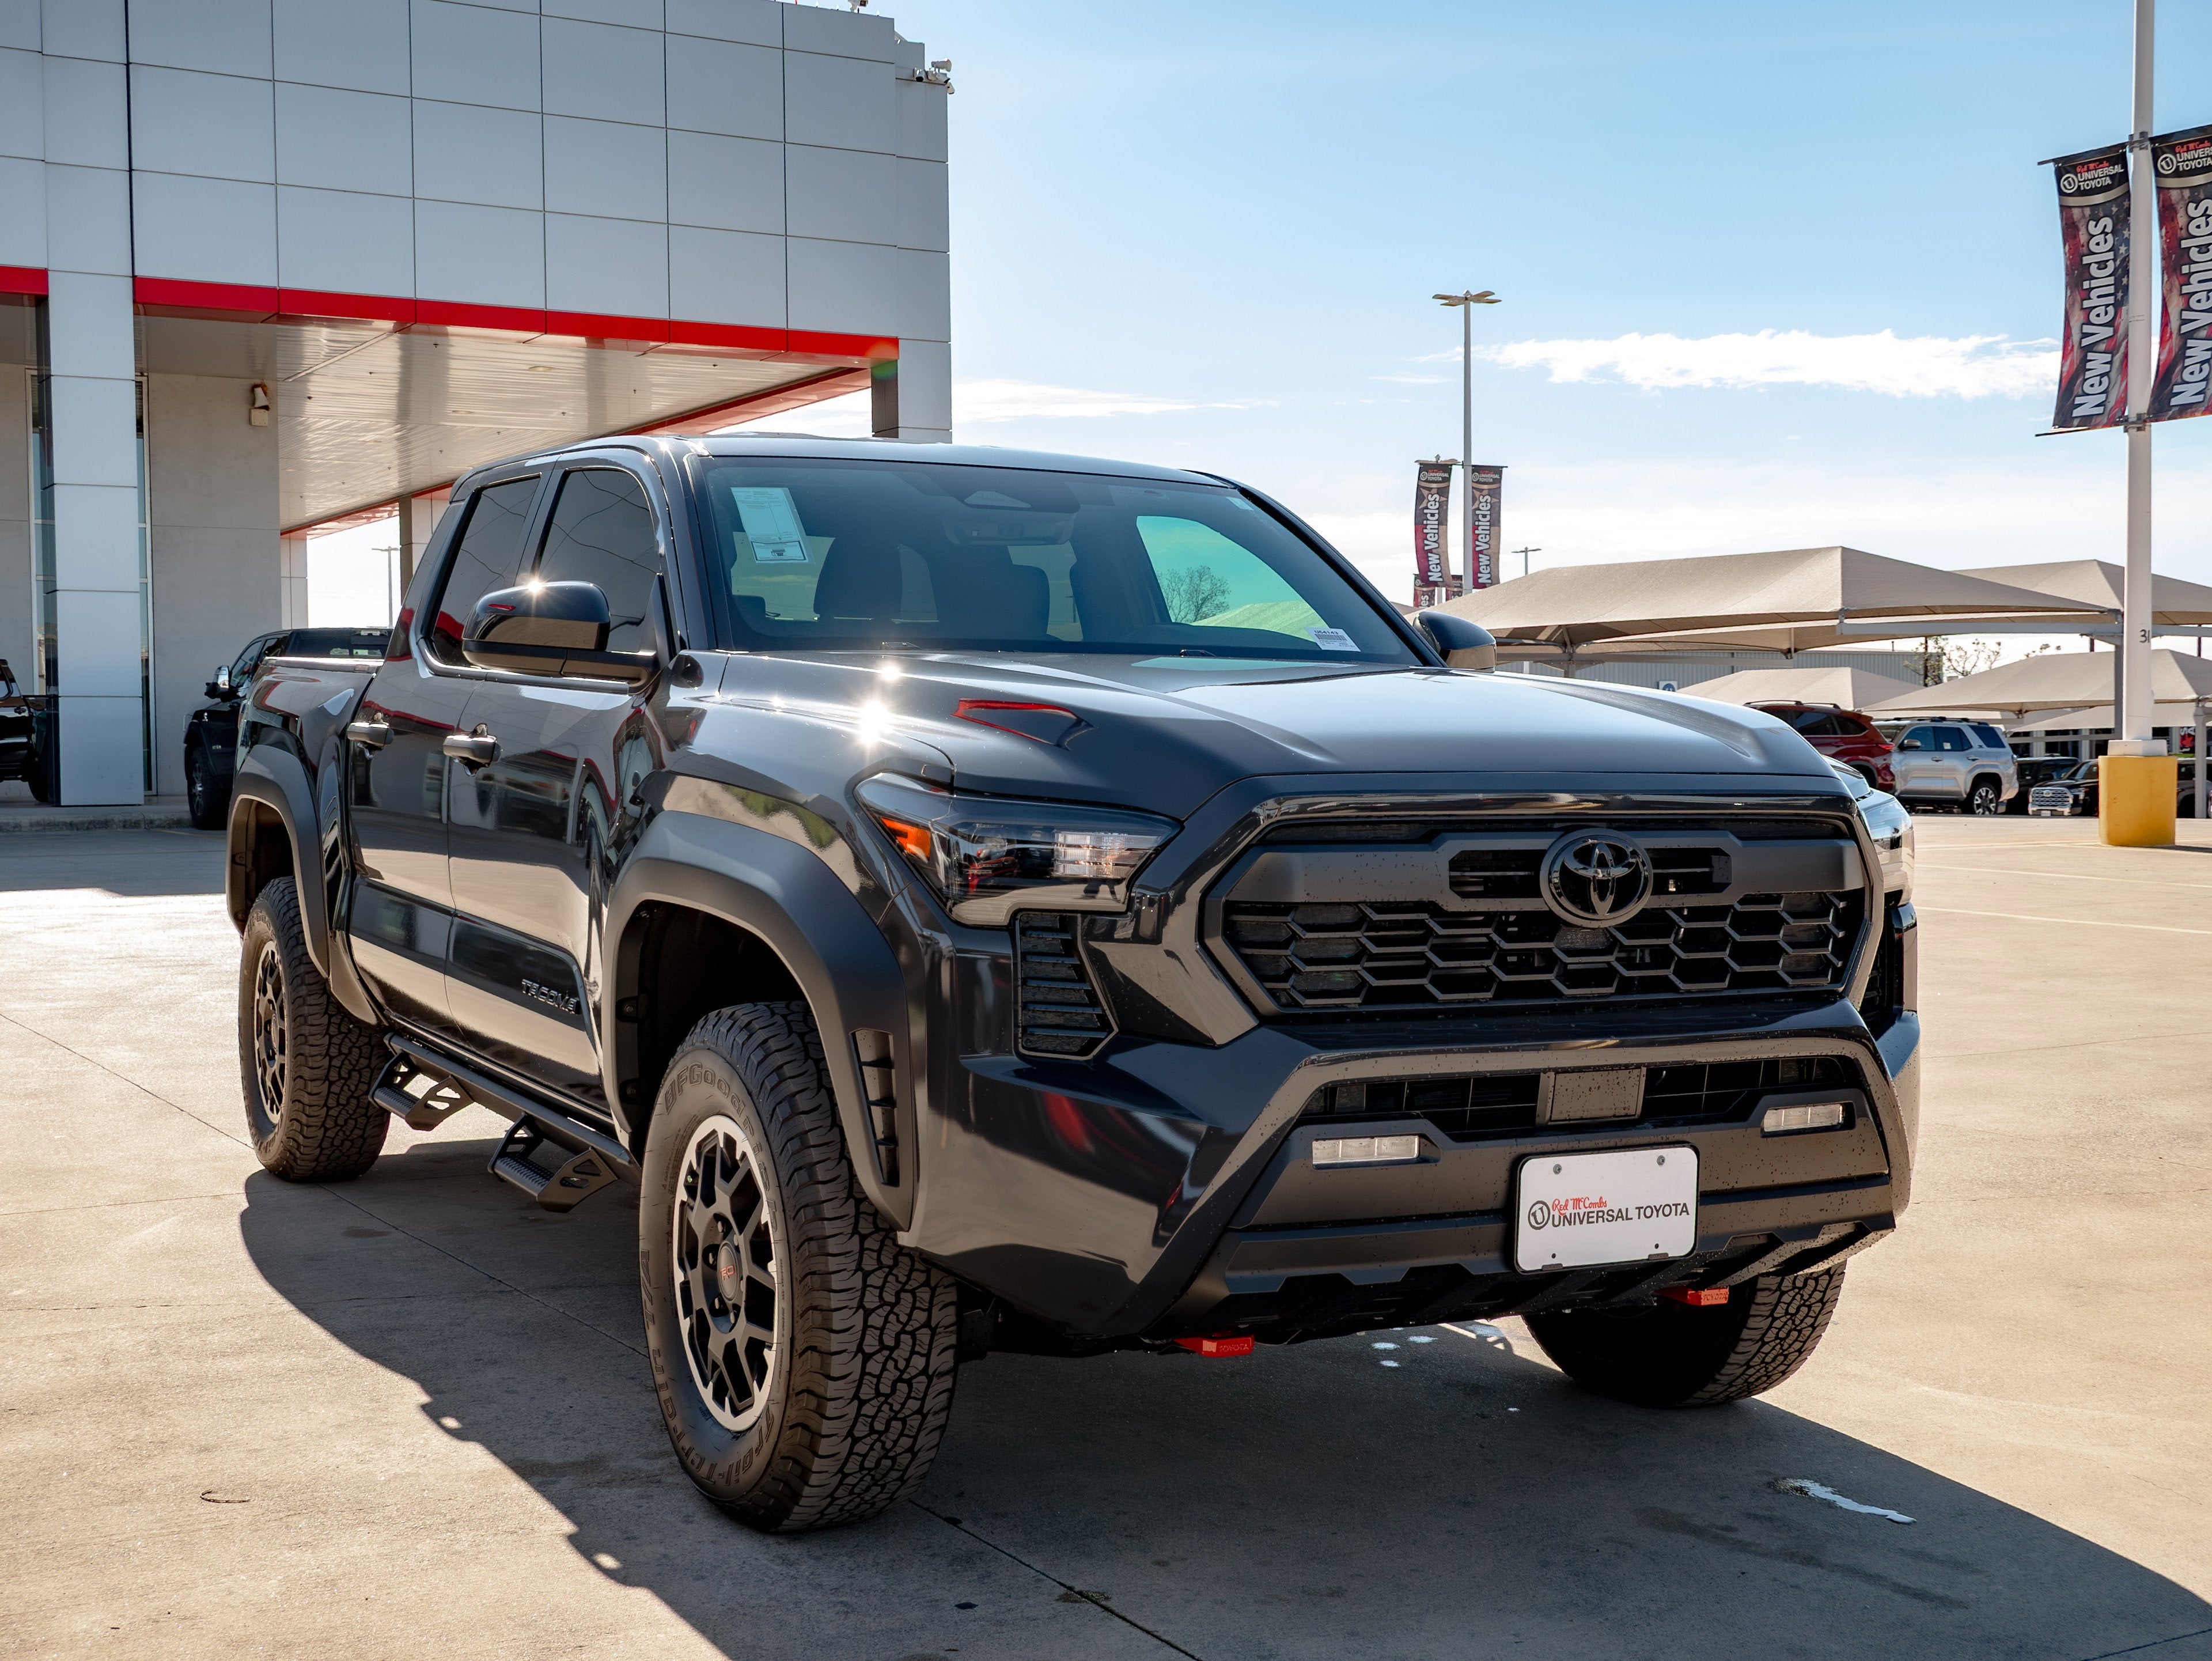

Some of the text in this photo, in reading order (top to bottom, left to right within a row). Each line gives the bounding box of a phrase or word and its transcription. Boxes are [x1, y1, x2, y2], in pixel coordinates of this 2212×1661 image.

[2077, 164, 2124, 181] UNIVERSAL
[2177, 157, 2212, 172] TOYOTA
[2078, 176, 2112, 191] TOYOTA
[2080, 216, 2115, 347] Vehicles
[2170, 198, 2212, 406] New Vehicles
[2072, 352, 2112, 417] New
[1423, 494, 1440, 550] Vehicles
[1475, 495, 1492, 584] New Vehicles
[1427, 553, 1444, 582] New
[2139, 629, 2150, 644] 31
[522, 979, 577, 1014] TACOMA
[1552, 1196, 1607, 1216] Red McCombs
[1552, 1202, 1690, 1228] UNIVERSAL TOYOTA
[719, 1265, 734, 1280] TRD
[1219, 1344, 1249, 1352] TOYOTA
